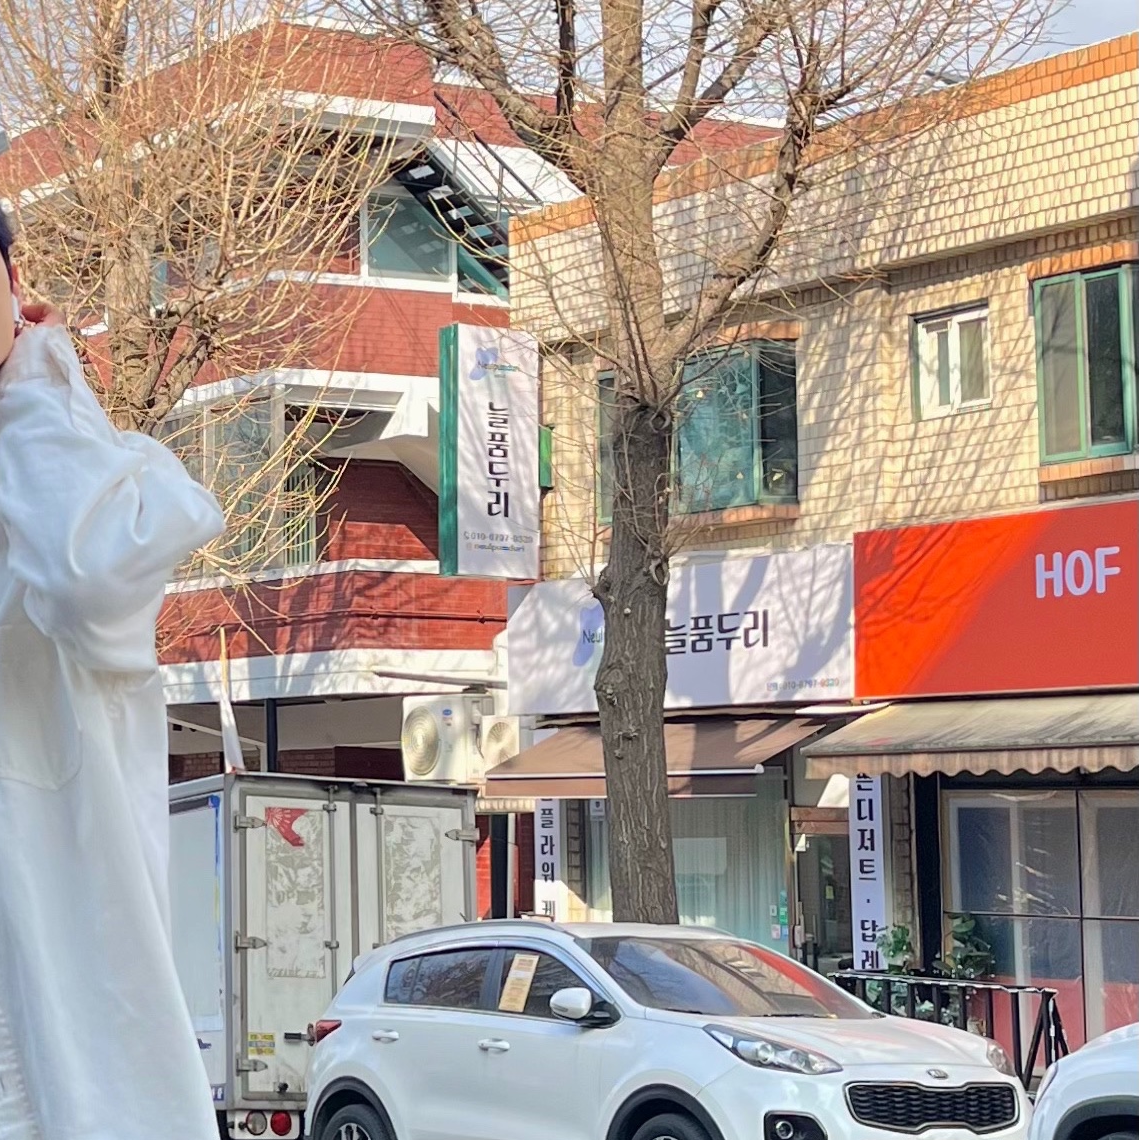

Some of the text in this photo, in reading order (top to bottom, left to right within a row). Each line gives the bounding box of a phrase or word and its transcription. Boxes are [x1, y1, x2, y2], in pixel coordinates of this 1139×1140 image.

[487, 401, 509, 517] 늘품두리
[1035, 546, 1121, 599] HOF
[665, 610, 768, 654] 늘품두리
[540, 799, 555, 882] 플라워
